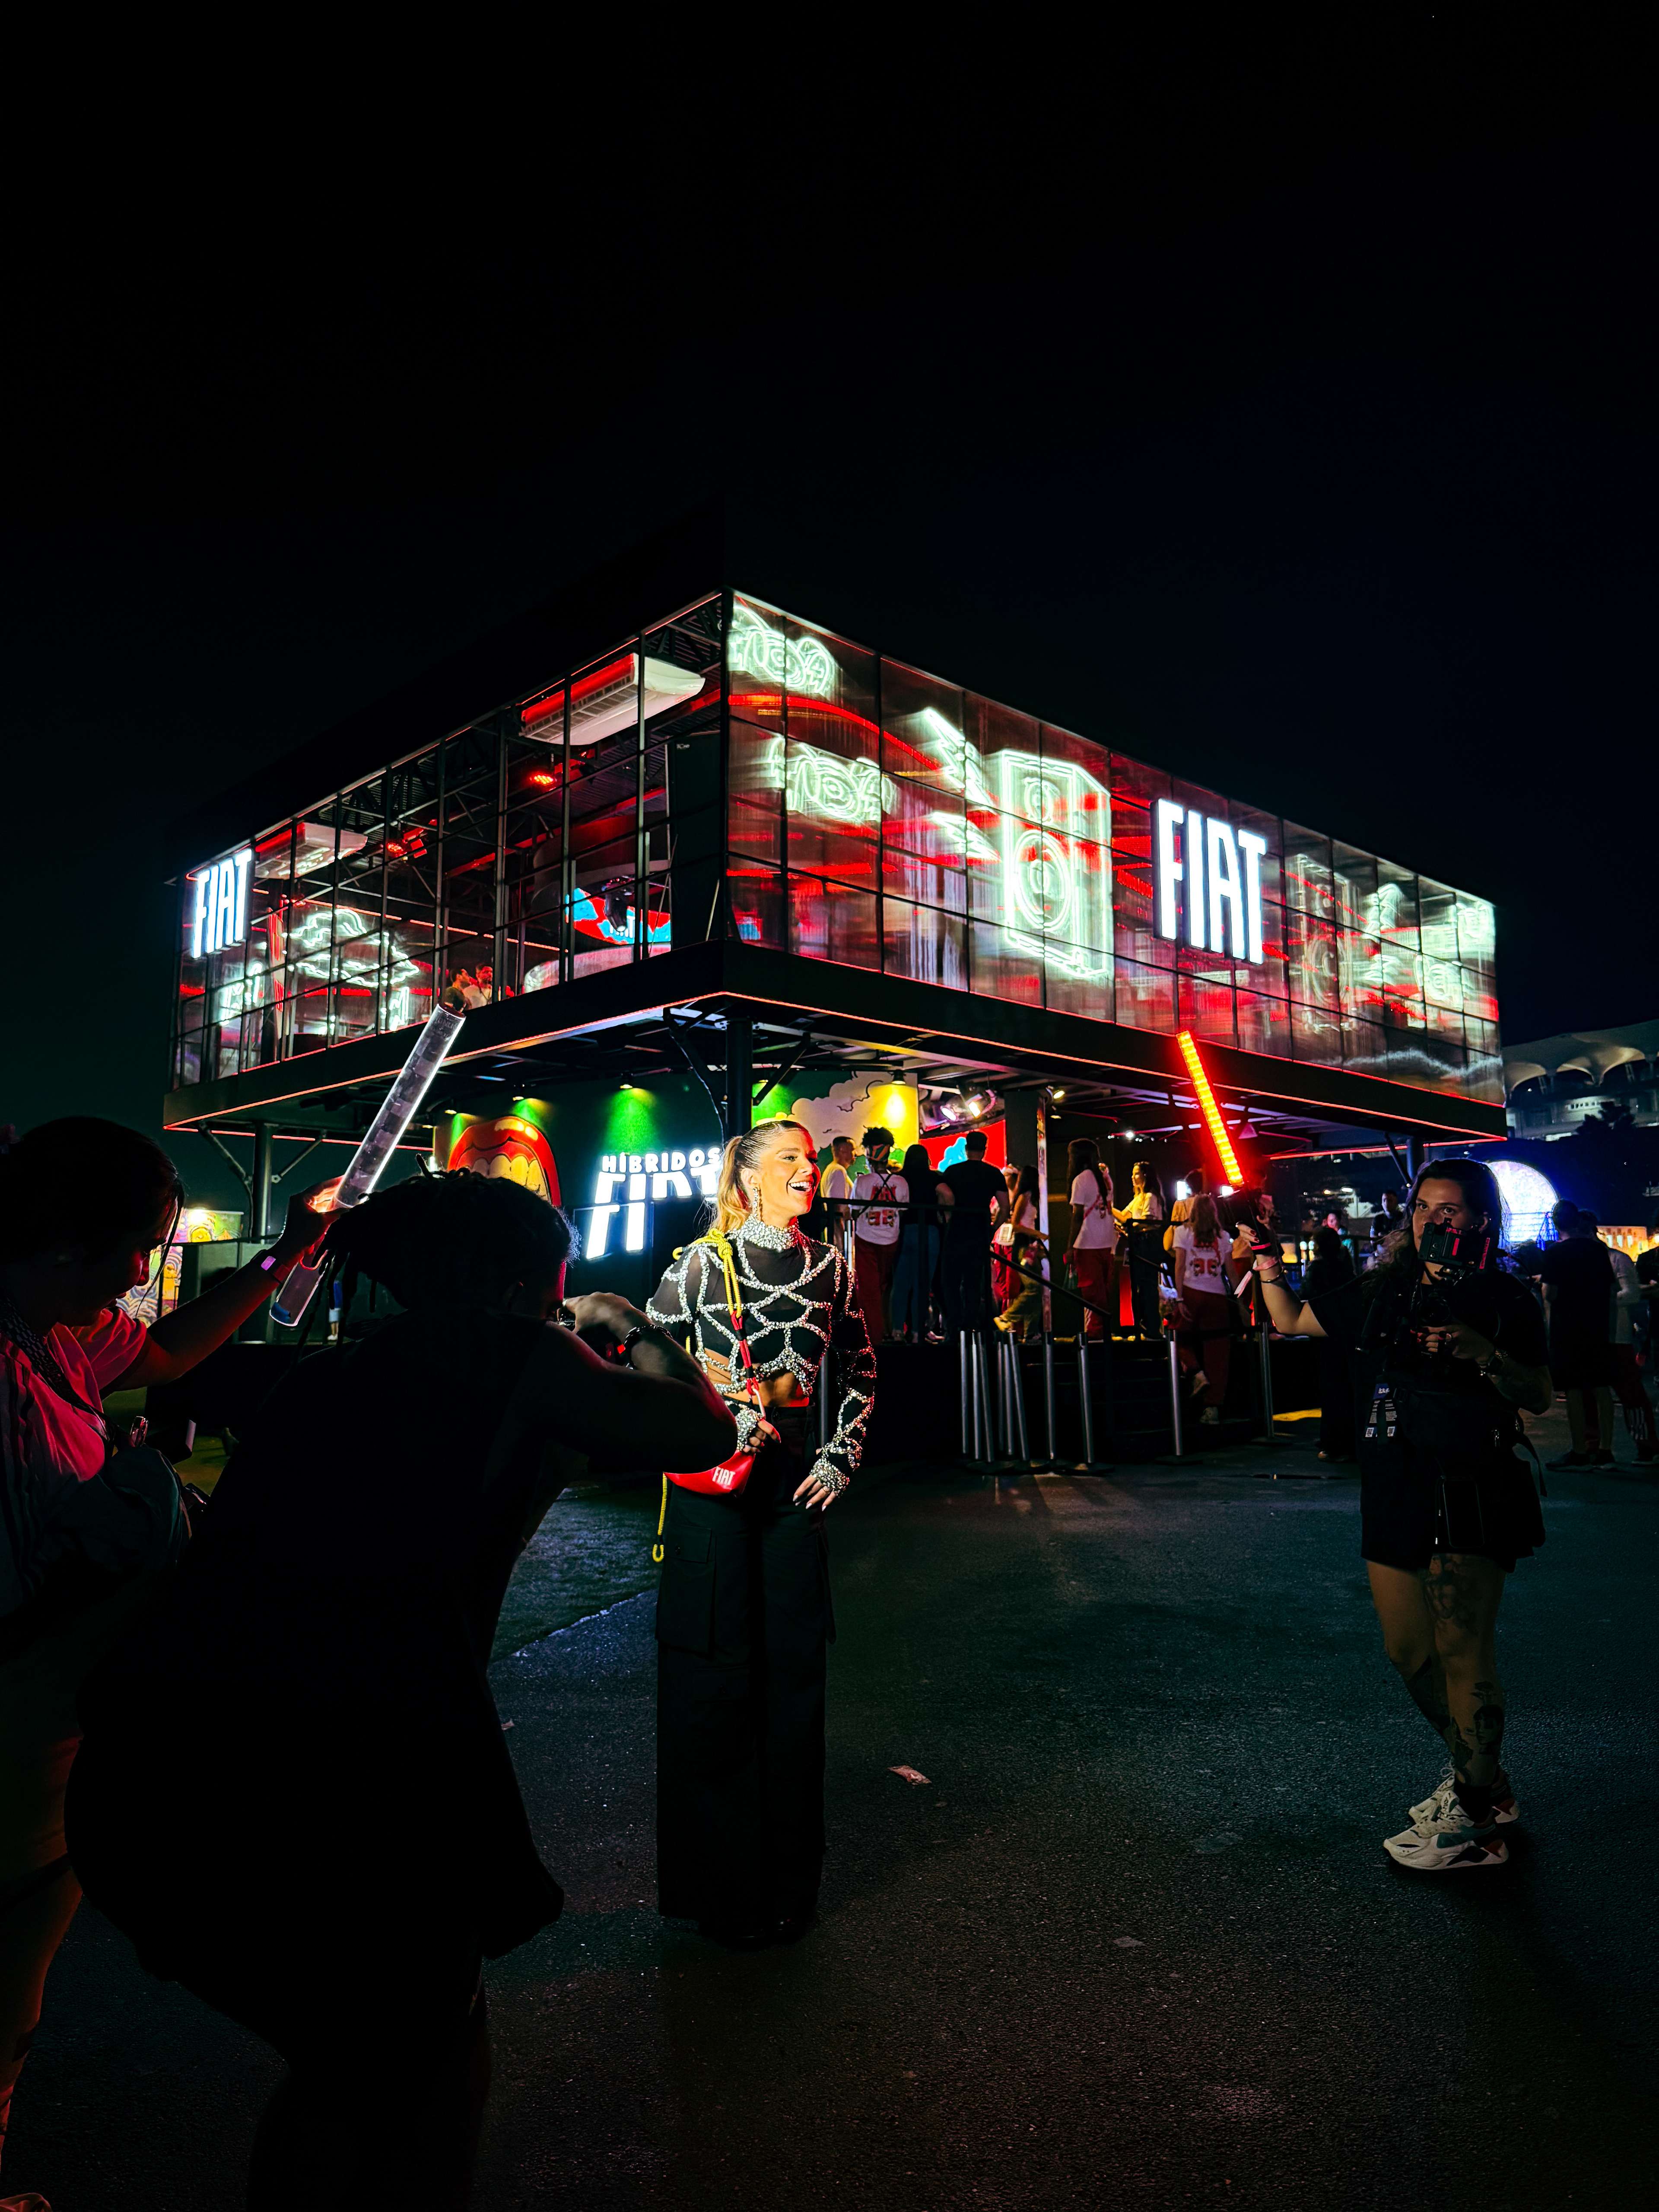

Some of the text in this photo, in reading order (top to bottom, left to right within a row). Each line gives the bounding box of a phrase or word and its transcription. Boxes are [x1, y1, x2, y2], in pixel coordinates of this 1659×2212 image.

[191, 849, 252, 959] FIAT
[1157, 798, 1266, 965] FIAT
[602, 1147, 721, 1173] HÍBRIDOS
[712, 1466, 736, 1486] FIAT
